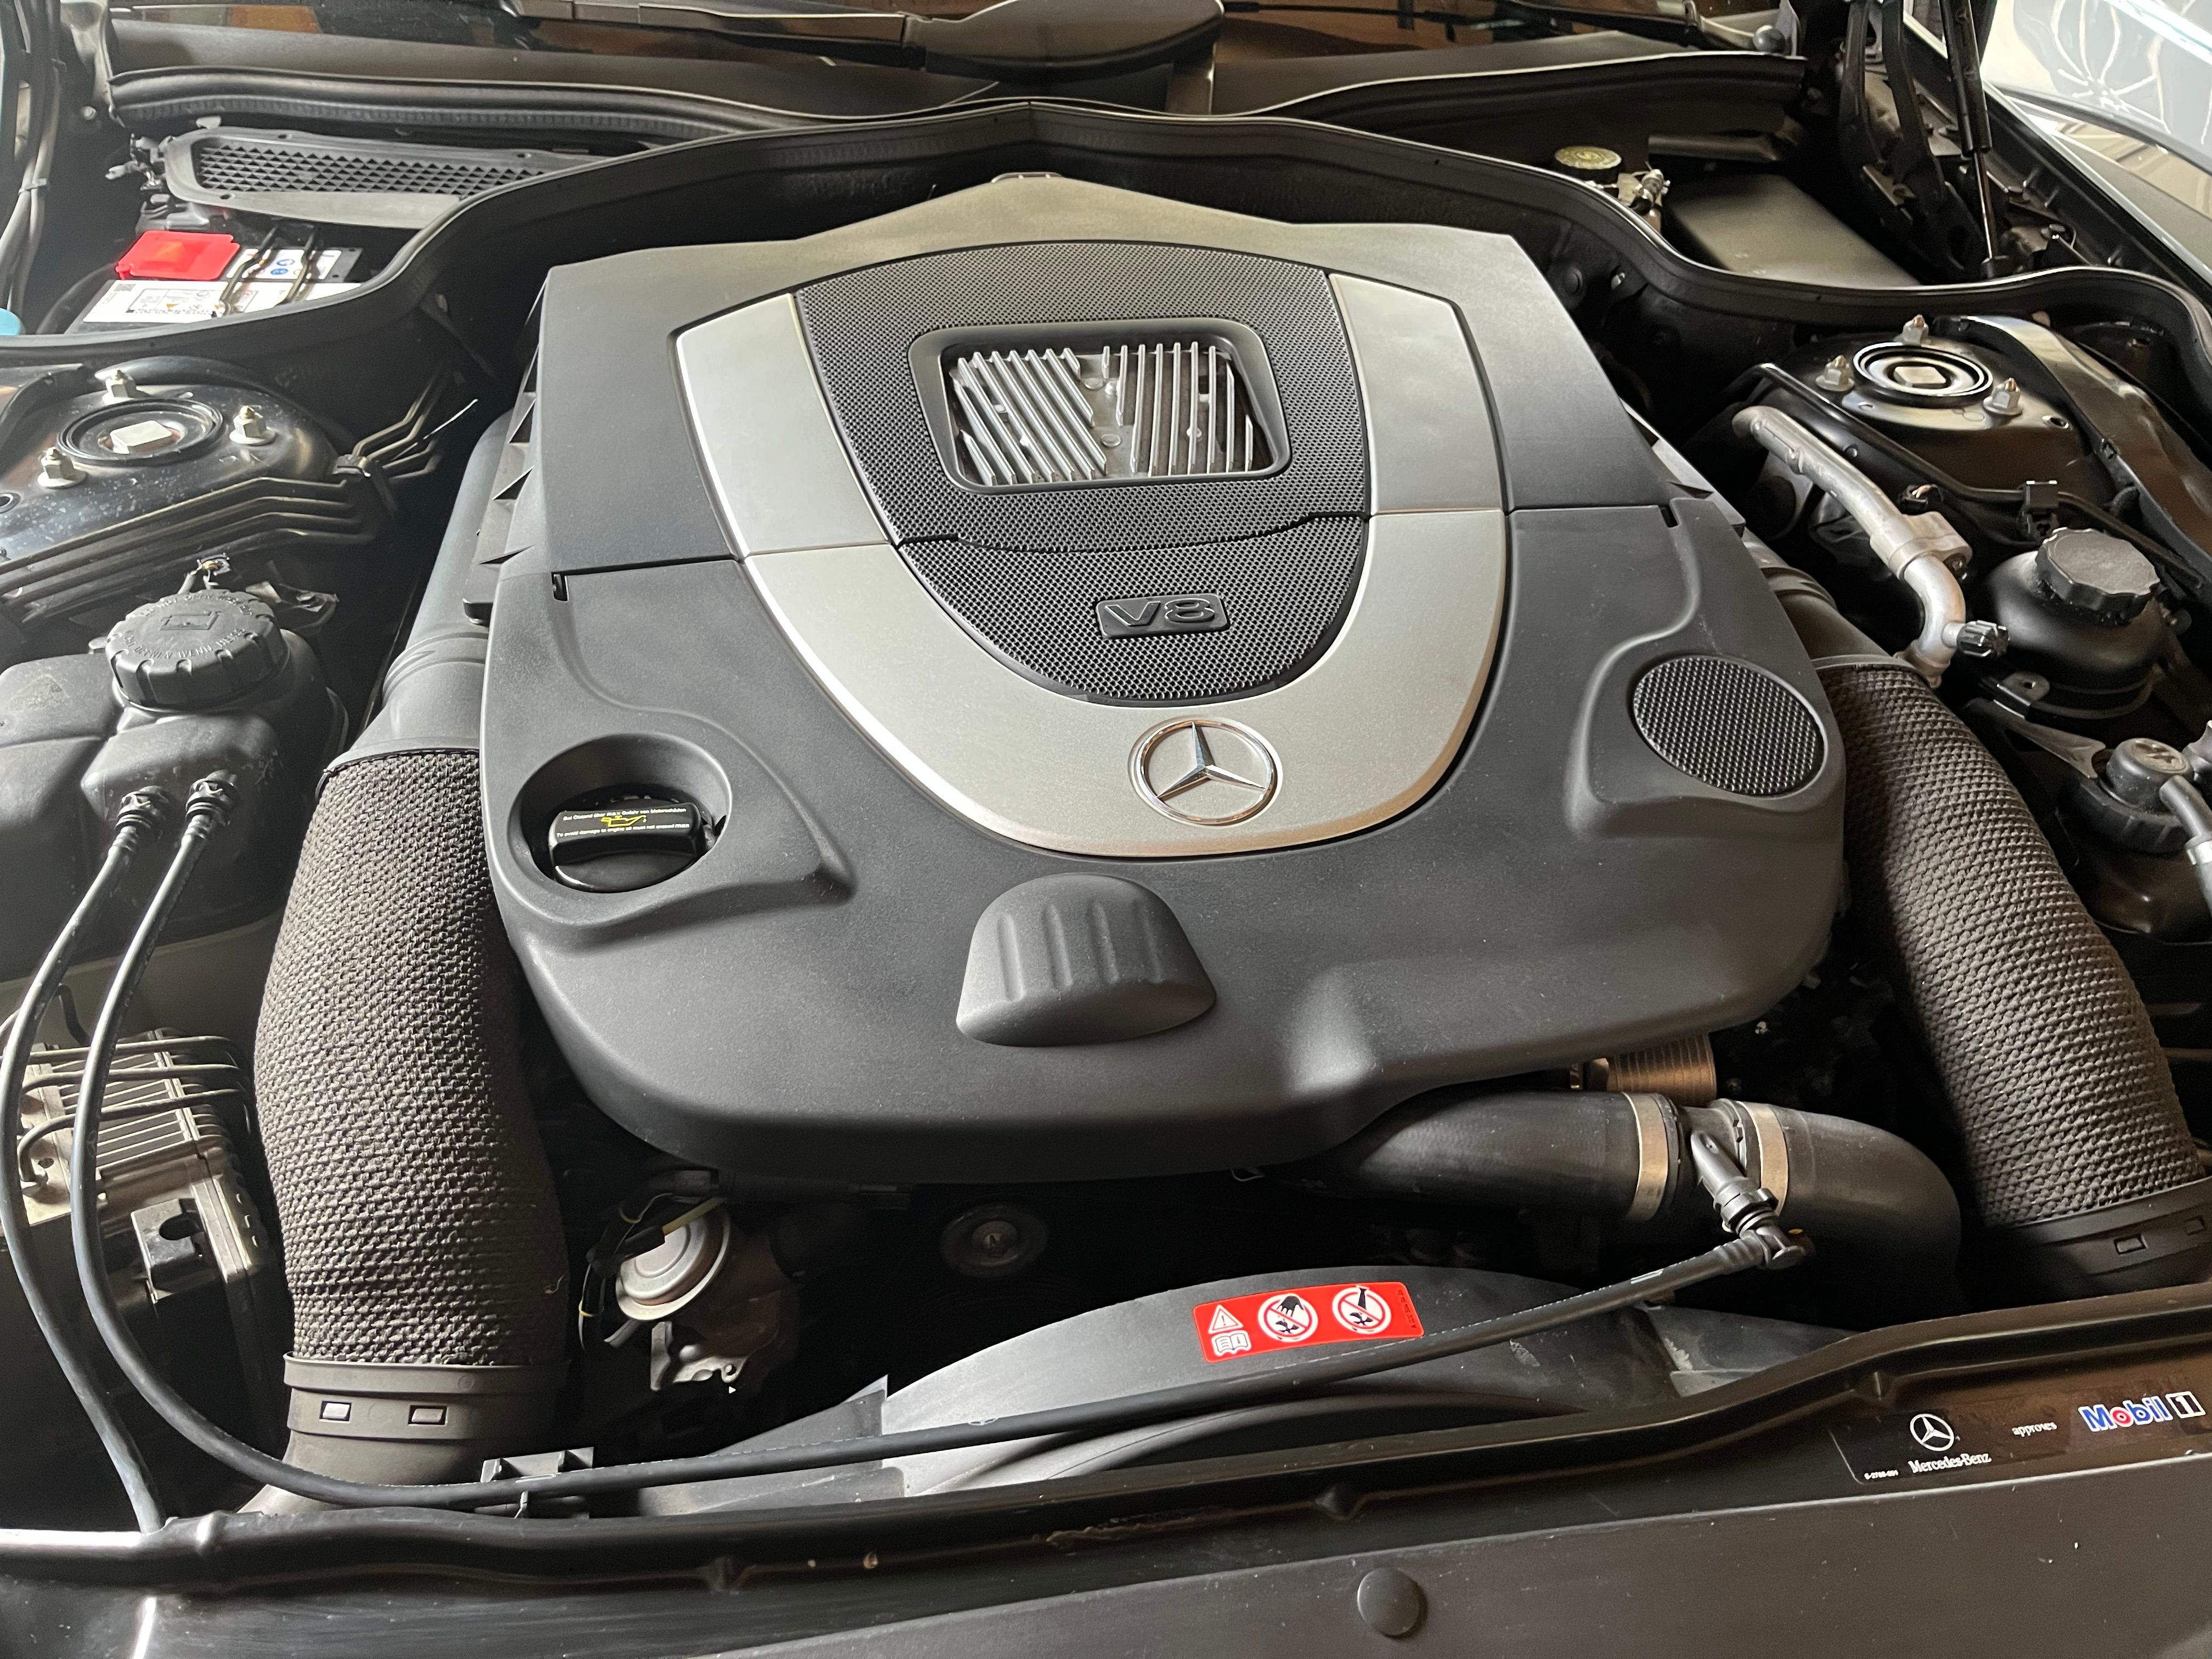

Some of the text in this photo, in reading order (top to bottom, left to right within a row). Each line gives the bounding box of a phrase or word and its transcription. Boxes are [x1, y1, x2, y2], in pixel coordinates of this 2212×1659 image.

[1104, 597, 1216, 627] V8
[2011, 1421, 2058, 1437] approves
[2078, 1395, 2174, 1432] Mobil
[1907, 1453, 1992, 1474] Mercedes-Benz
